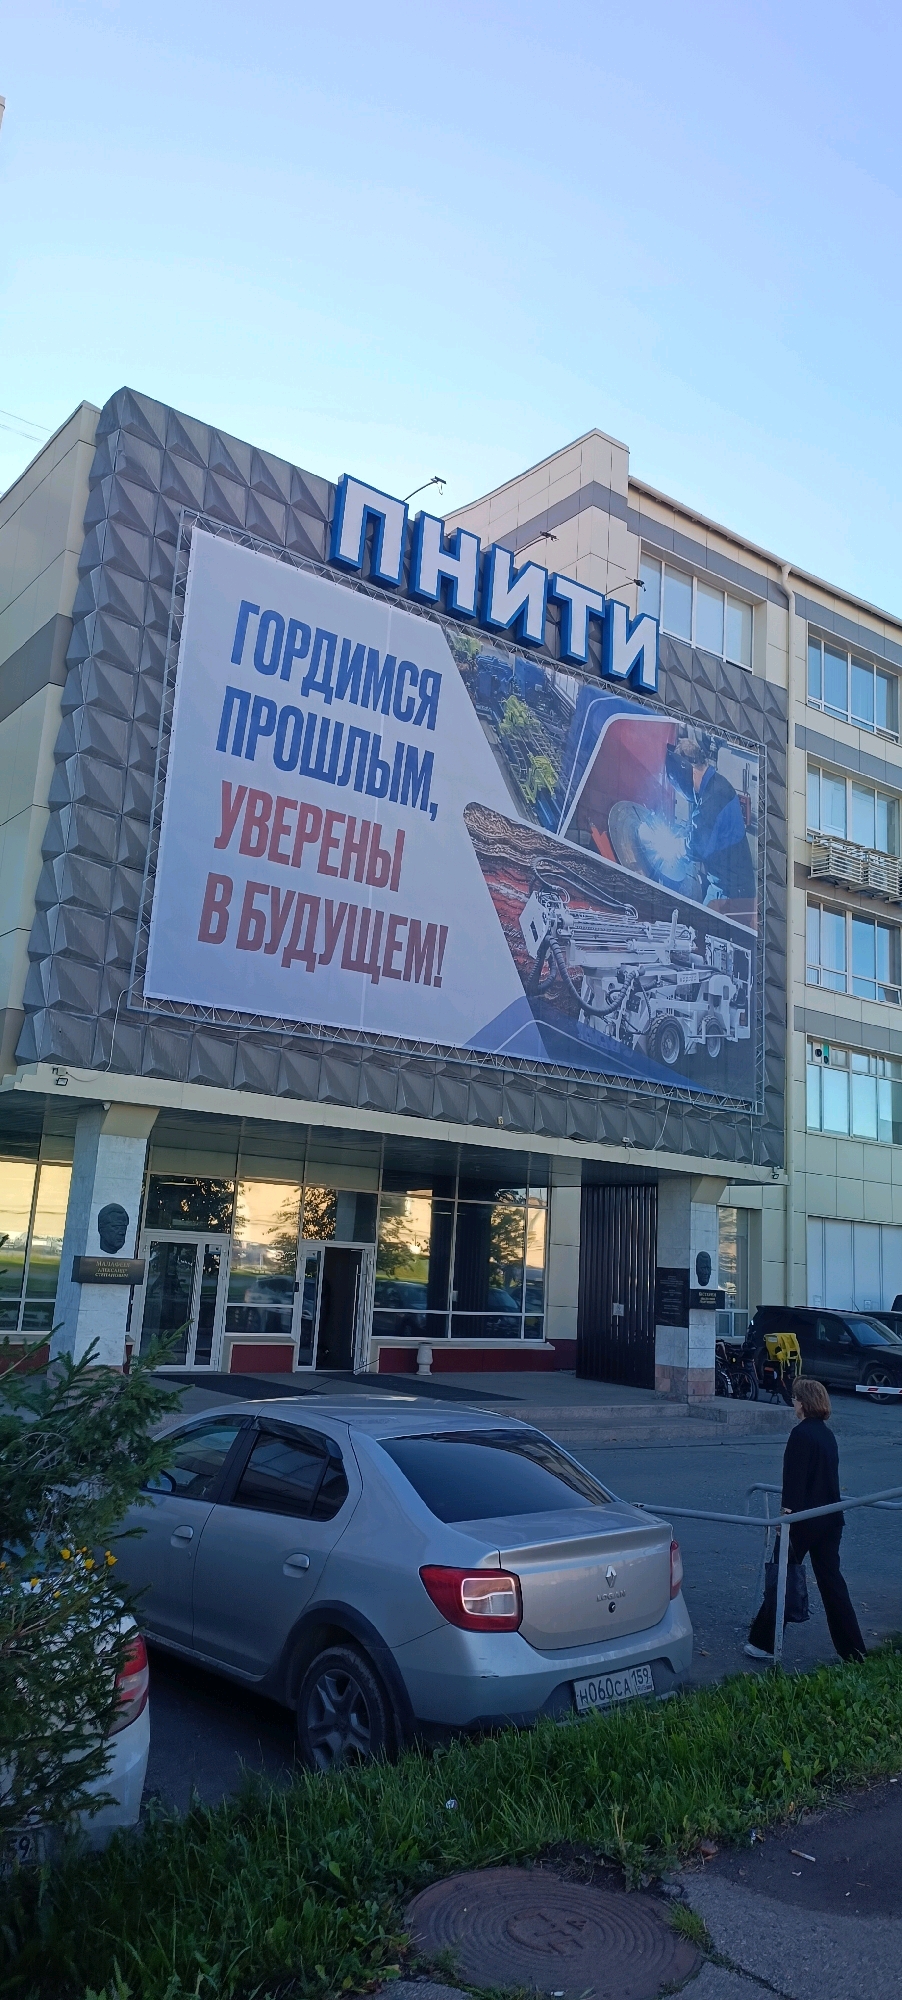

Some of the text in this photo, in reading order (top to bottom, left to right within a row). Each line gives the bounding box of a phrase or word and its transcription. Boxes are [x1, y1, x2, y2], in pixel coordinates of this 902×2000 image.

[329, 473, 659, 694] ПНИТИ
[231, 600, 443, 731] ГОРДИМСЯ
[216, 686, 439, 822] ПРОШЛЫМ,
[214, 780, 405, 892] УВЕРЕНЫ
[198, 872, 449, 988] В БУДУЩЕМ!
[596, 1589, 626, 1602] LOGAN
[579, 1667, 649, 1706] Н060СА 159
